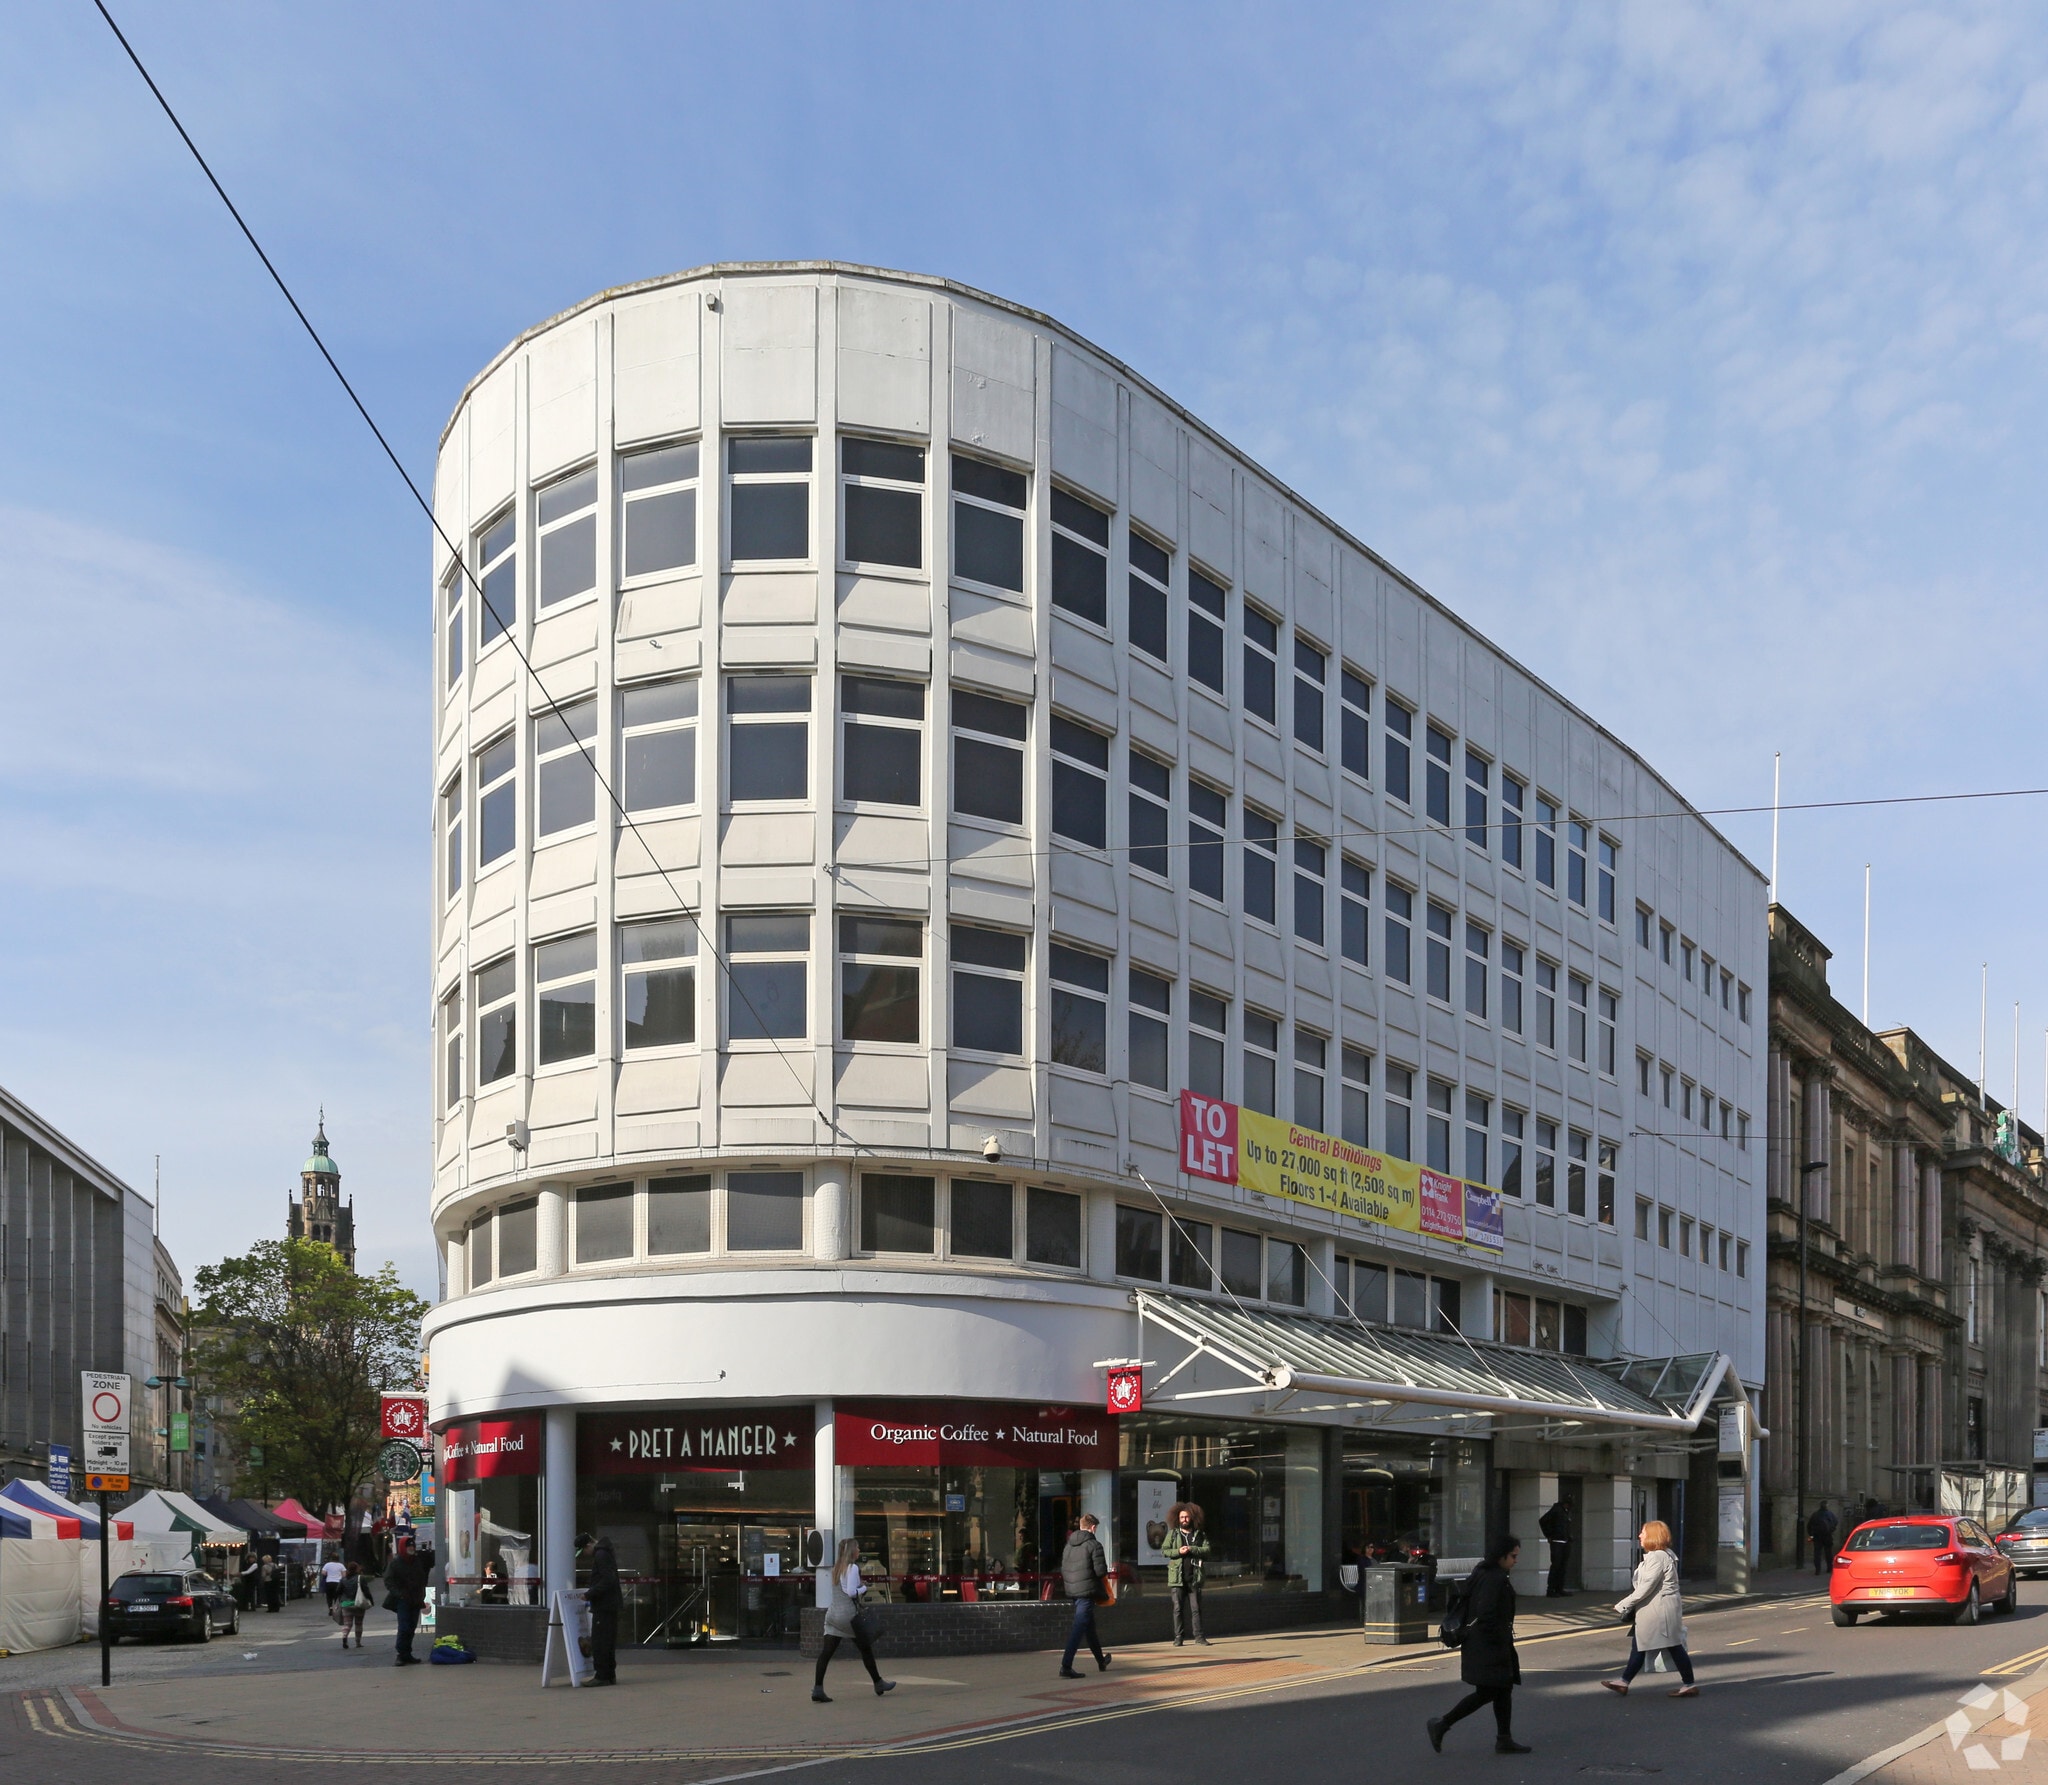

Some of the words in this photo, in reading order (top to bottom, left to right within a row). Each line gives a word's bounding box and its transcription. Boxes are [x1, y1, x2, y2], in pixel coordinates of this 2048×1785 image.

[1191, 1097, 1227, 1138] TO
[1187, 1134, 1234, 1178] LET
[1289, 1127, 1331, 1155] Central
[1332, 1140, 1382, 1173] Buildings
[1247, 1139, 1262, 1163] Up
[1266, 1145, 1277, 1165] to
[1281, 1150, 1320, 1177] 27,000
[1323, 1166, 1337, 1185] sq
[1340, 1167, 1348, 1185] ft
[1351, 1171, 1385, 1196] (2,508
[1388, 1185, 1399, 1204] sq
[1402, 1188, 1415, 1208] m)
[1433, 1178, 1452, 1193] Knight
[1280, 1174, 1315, 1200] Floors
[1319, 1186, 1337, 1206] 1-4
[1340, 1192, 1389, 1220] Available
[1466, 1189, 1492, 1206] Campbell
[92, 1381, 121, 1390] ZONE
[386, 1401, 404, 1416] ORGANIC
[405, 1401, 420, 1416] COFFEE
[387, 1421, 407, 1434] NATURAL
[408, 1421, 418, 1433] FOOD
[870, 1424, 937, 1444] Organic
[940, 1424, 989, 1441] Coffee
[1012, 1426, 1063, 1443] Natural
[1067, 1429, 1098, 1445] Food
[470, 1437, 498, 1455] Natural
[500, 1434, 524, 1452] Food
[629, 1428, 674, 1459] PRET
[680, 1429, 692, 1457] A
[700, 1425, 777, 1457] MANGER
[380, 1446, 414, 1461] STARBUCKS
[384, 1469, 411, 1480] COFFEE
